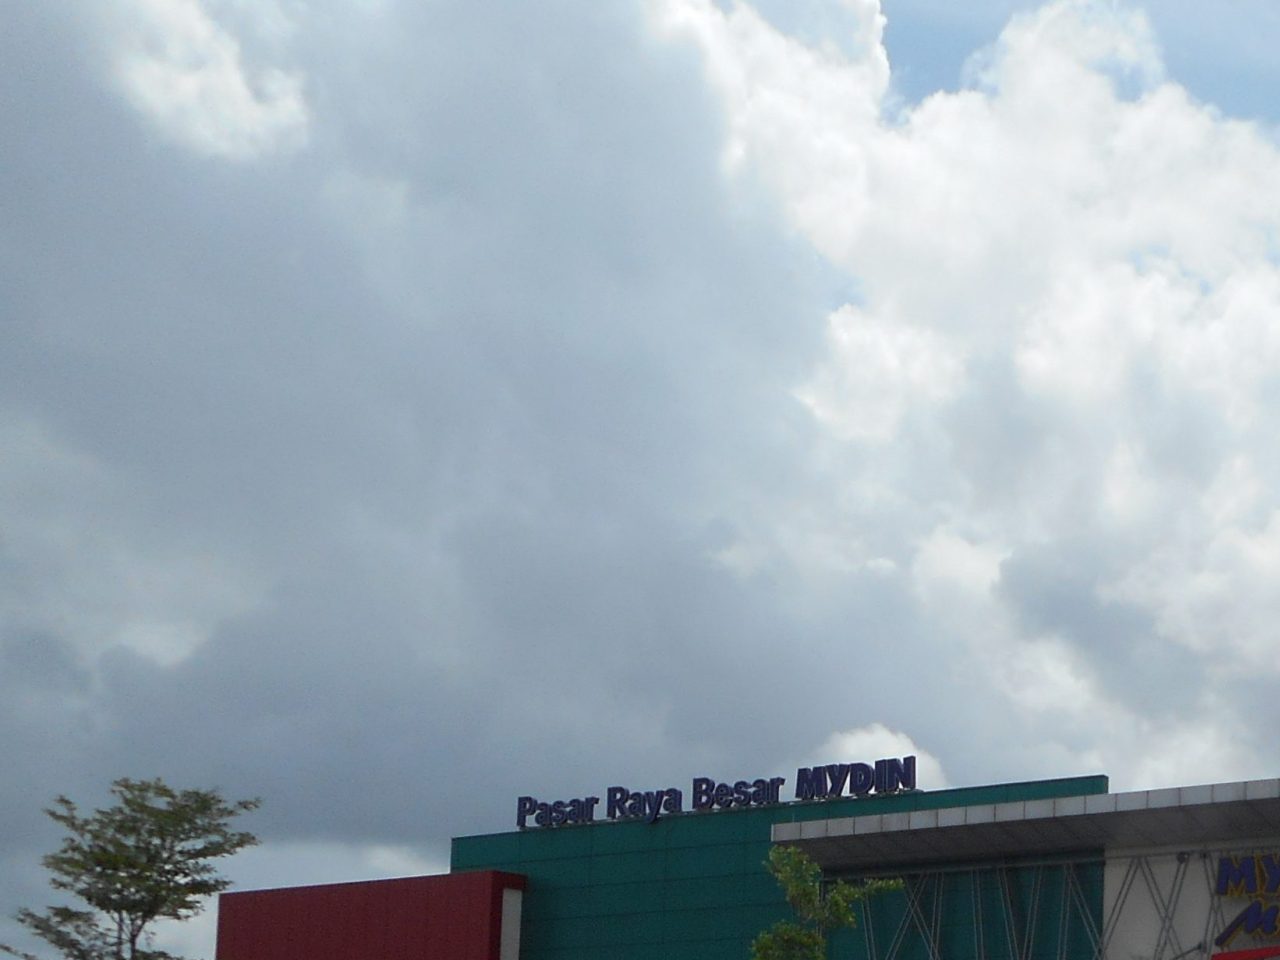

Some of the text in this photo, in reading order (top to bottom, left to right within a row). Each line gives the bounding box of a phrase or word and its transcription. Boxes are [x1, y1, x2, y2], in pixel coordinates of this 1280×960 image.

[516, 756, 917, 828] Pasar Raya Besar MYDIN
